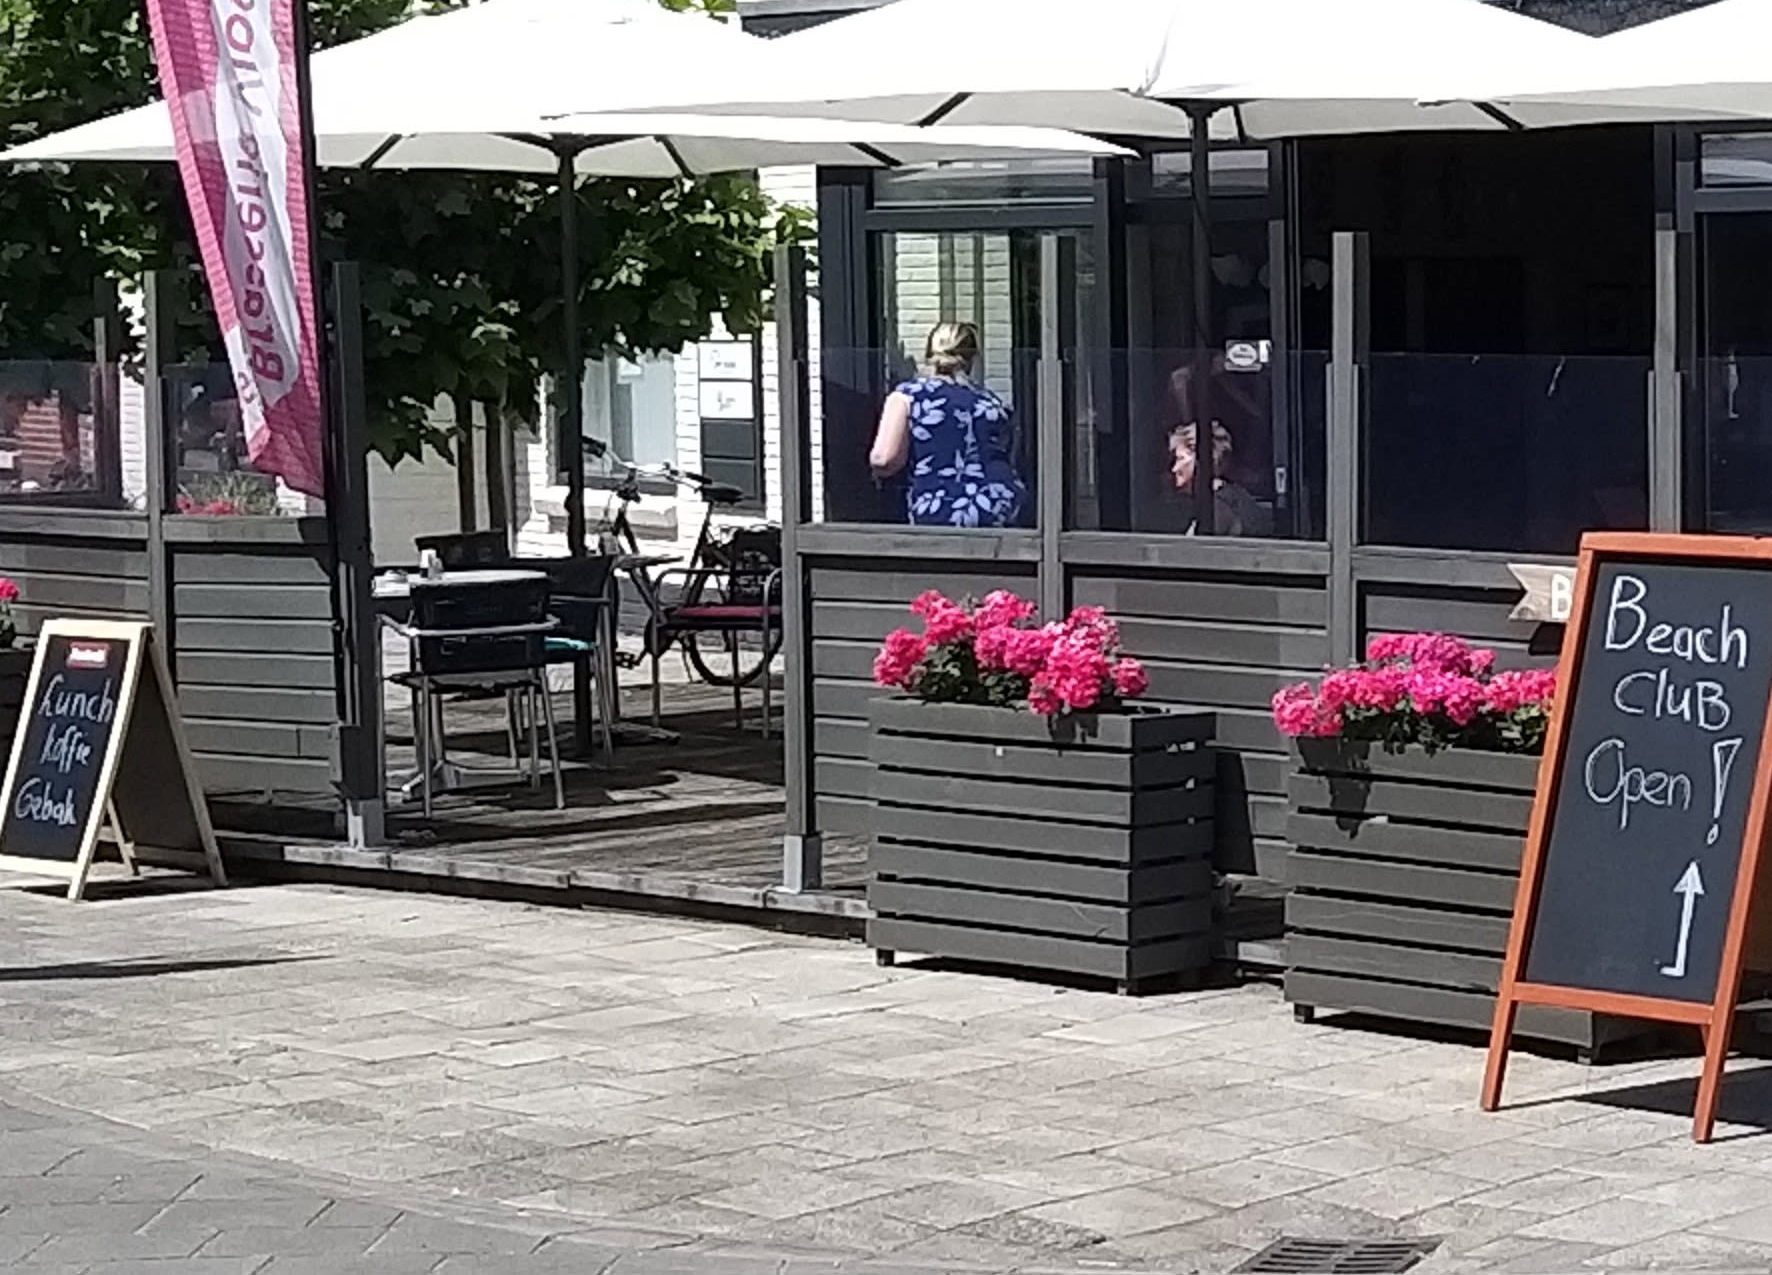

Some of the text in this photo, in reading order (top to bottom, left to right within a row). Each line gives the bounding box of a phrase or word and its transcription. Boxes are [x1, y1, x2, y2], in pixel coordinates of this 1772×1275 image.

[1604, 575, 1748, 669] Beach
[38, 673, 114, 722] Lunch
[15, 777, 77, 826] Gebak
